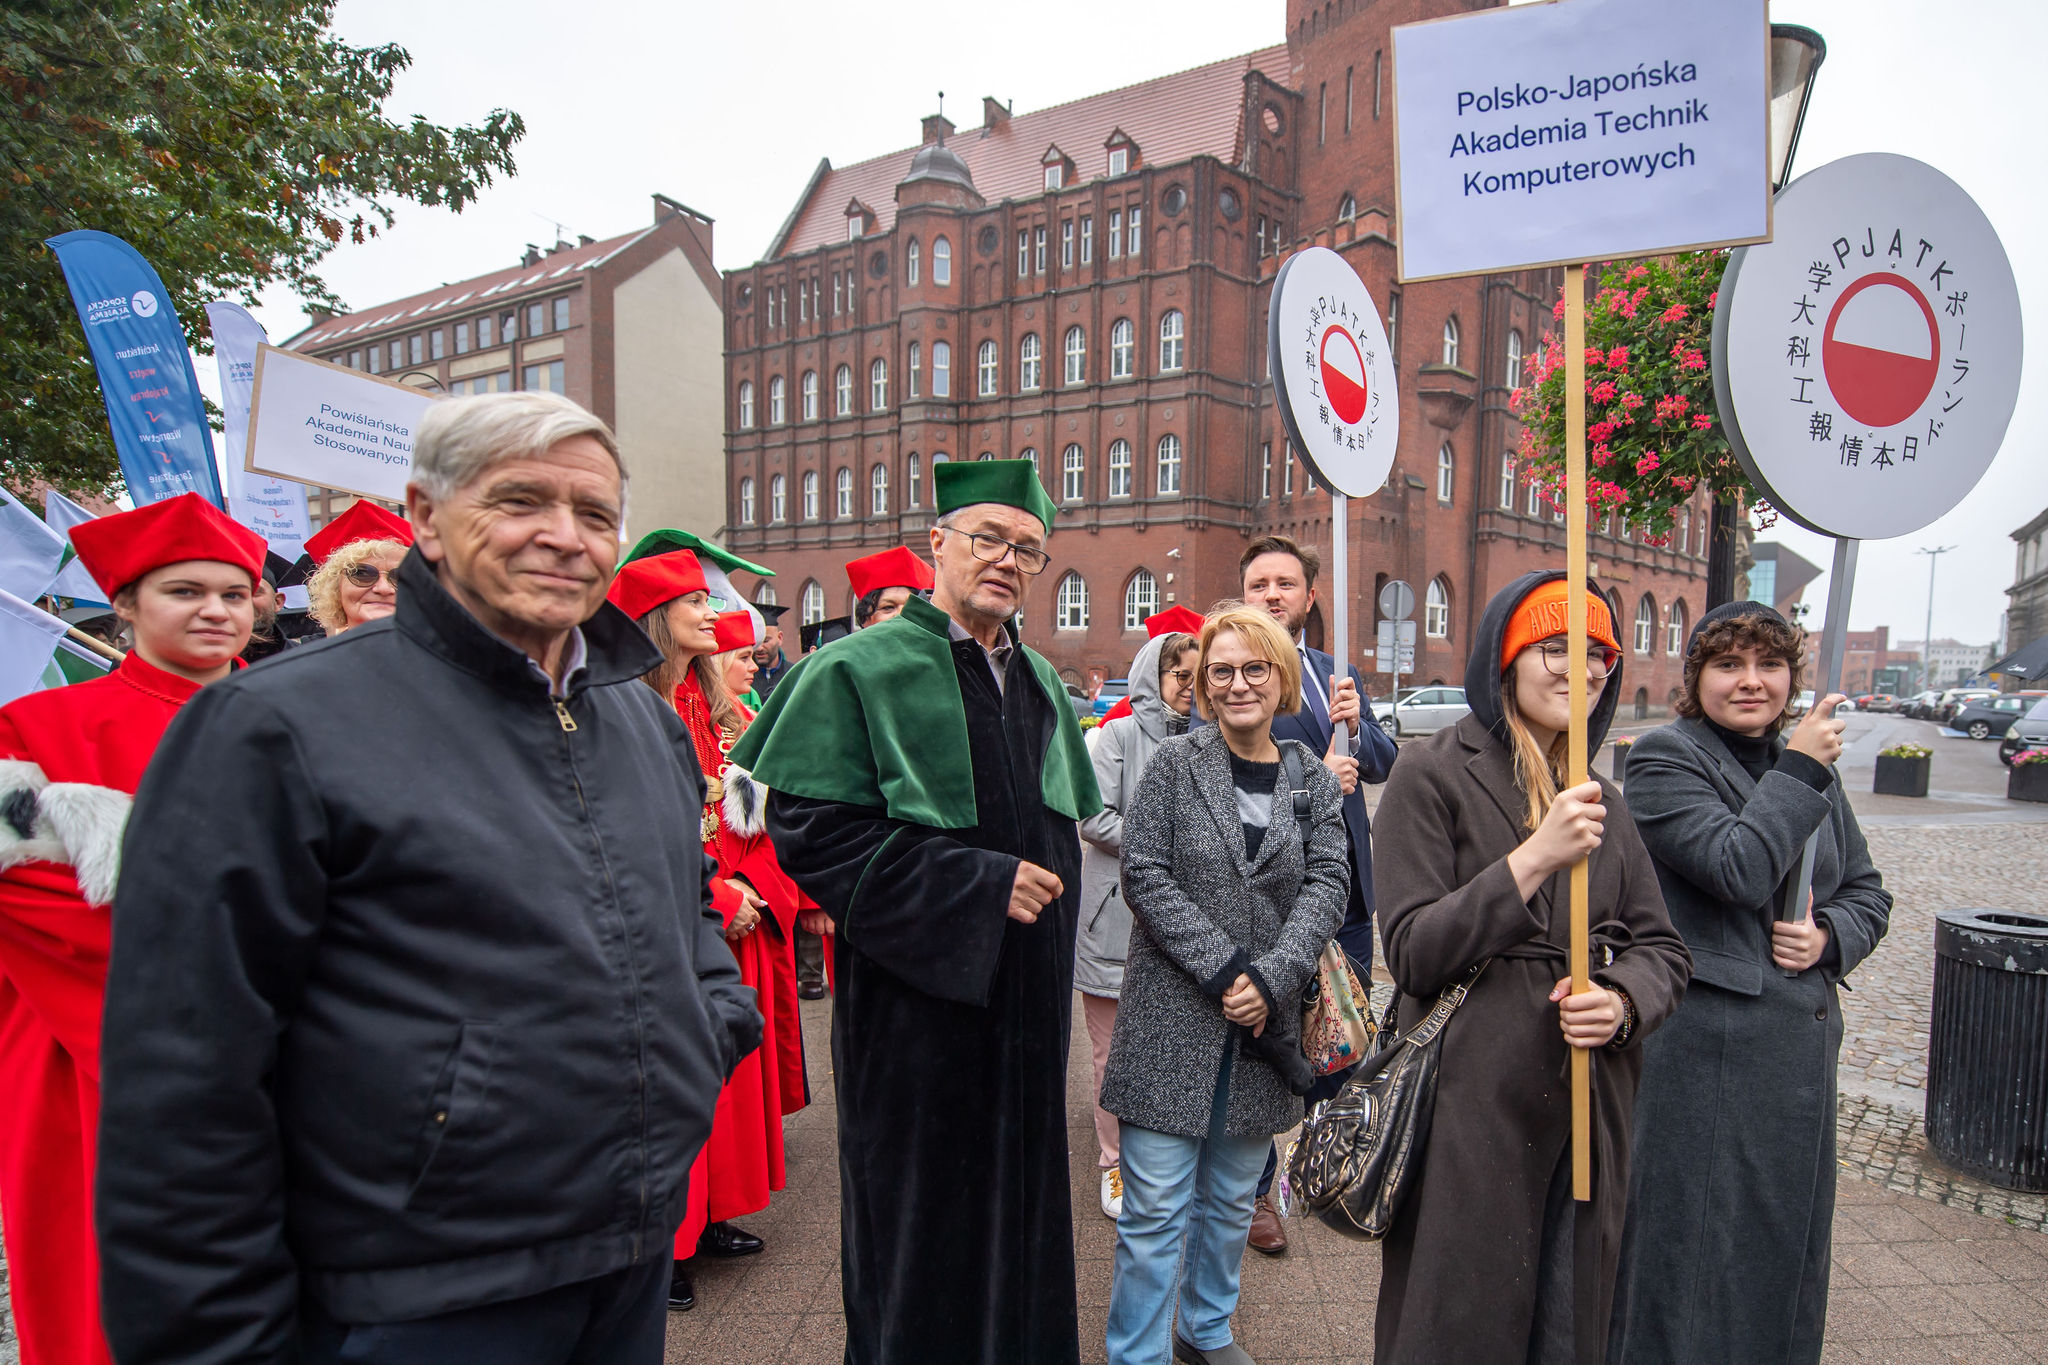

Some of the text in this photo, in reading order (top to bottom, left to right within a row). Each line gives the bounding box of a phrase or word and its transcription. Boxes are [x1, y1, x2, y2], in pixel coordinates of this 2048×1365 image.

[1457, 60, 1697, 116] Polsko-Japońska
[1450, 98, 1709, 158] Akademia Technik
[1463, 143, 1695, 196] Komputerowych
[1833, 227, 1953, 291] PJATK
[1318, 296, 1367, 347] PJATK
[305, 416, 378, 444] Akademia
[321, 403, 409, 436] Powiślańska
[313, 433, 409, 466] Stosowanych
[1529, 600, 1612, 643] AMSTDAM
